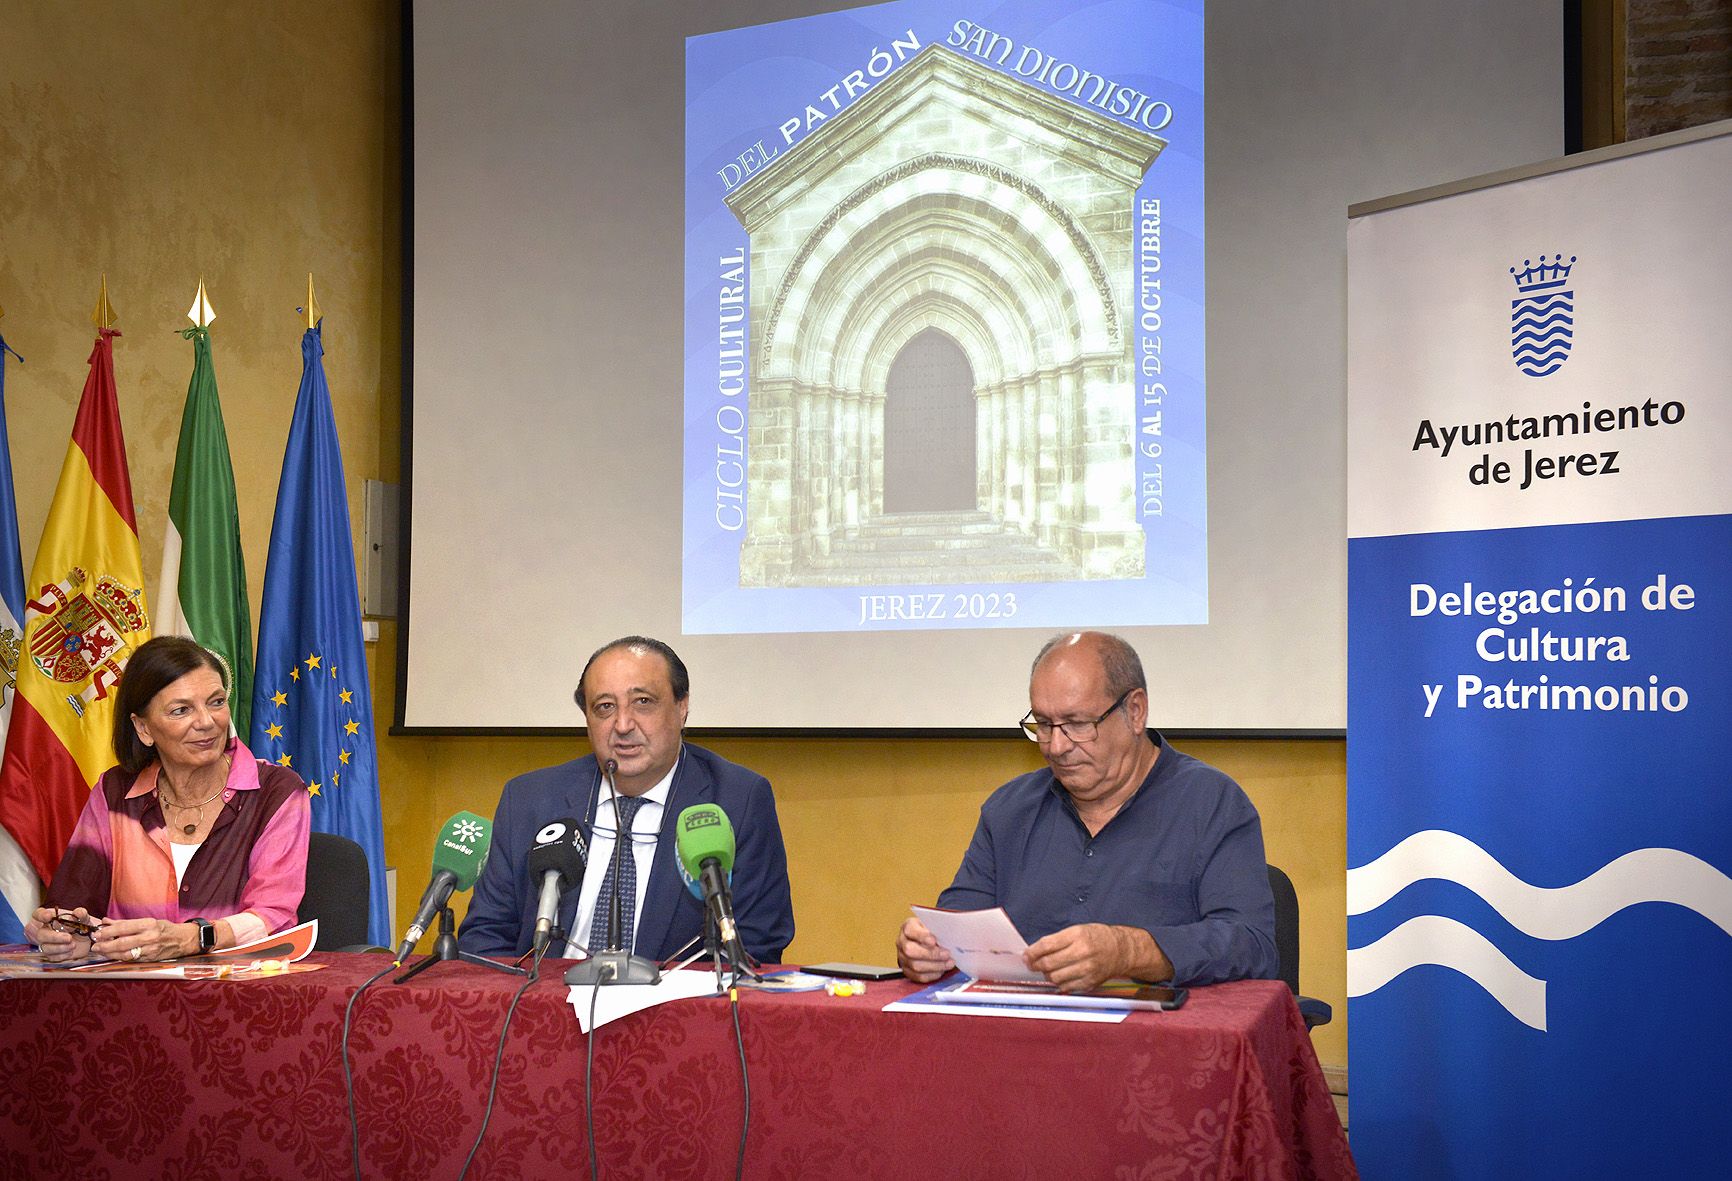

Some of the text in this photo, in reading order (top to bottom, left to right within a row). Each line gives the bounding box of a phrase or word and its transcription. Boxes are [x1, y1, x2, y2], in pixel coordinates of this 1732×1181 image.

[946, 18, 1175, 132] SAN DIONISIO
[716, 28, 922, 192] DEL PATRÓN
[1140, 199, 1168, 517] DEL 6 AL 15 DE OCTUBRE
[716, 247, 745, 531] CICLO CULTURAL
[1412, 397, 1686, 457] Ayuntamiento
[1469, 447, 1620, 490] de Jerez
[858, 592, 1018, 626] JEREZ 2023
[1410, 574, 1695, 625] Delegación de
[1475, 628, 1631, 663] Cultura
[1422, 674, 1689, 718] y Patrimonio
